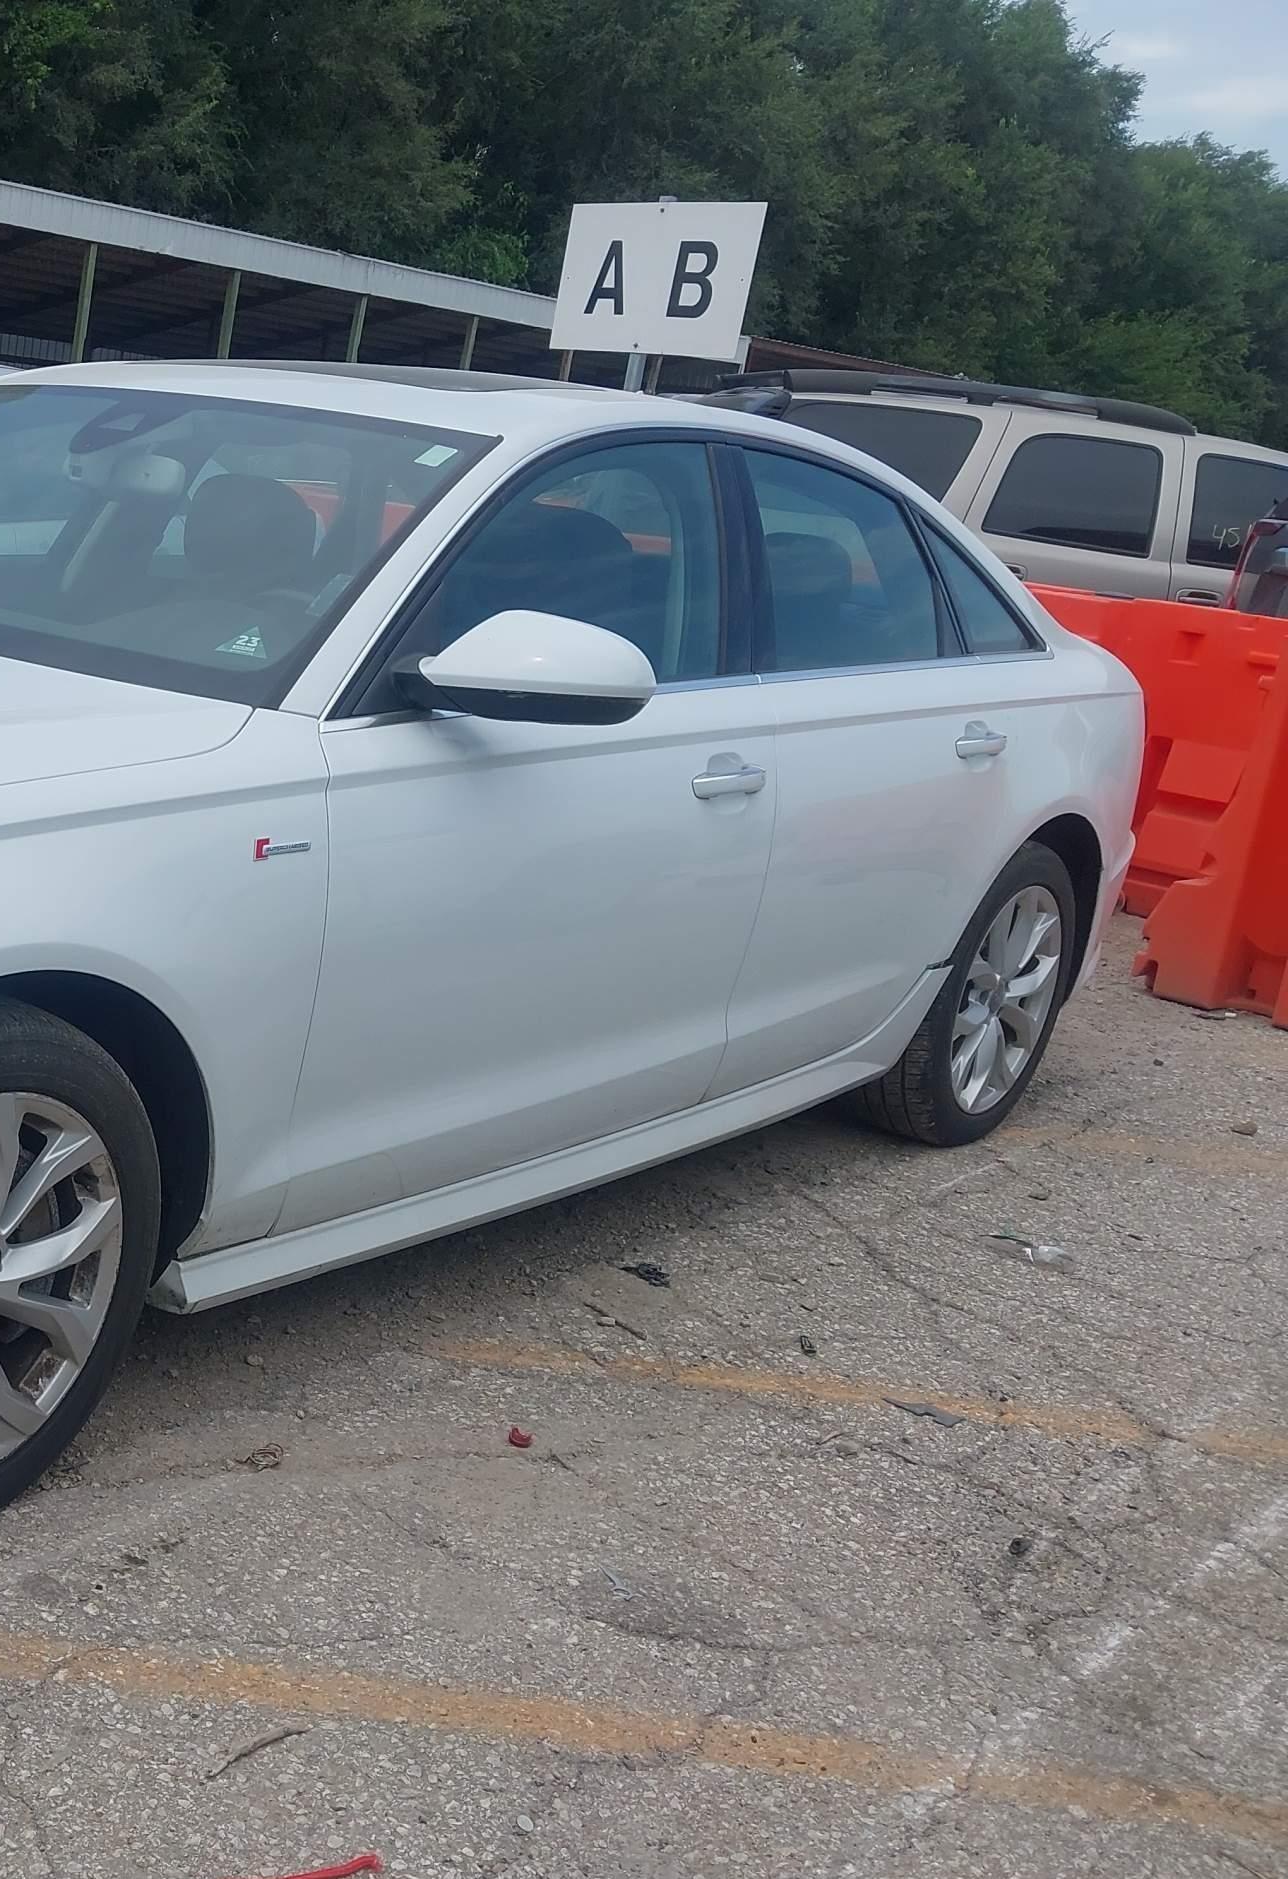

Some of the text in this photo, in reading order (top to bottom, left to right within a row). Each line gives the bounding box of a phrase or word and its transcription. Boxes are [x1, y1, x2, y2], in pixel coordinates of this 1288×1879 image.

[583, 239, 719, 319] A B
[235, 635, 261, 647] 23
